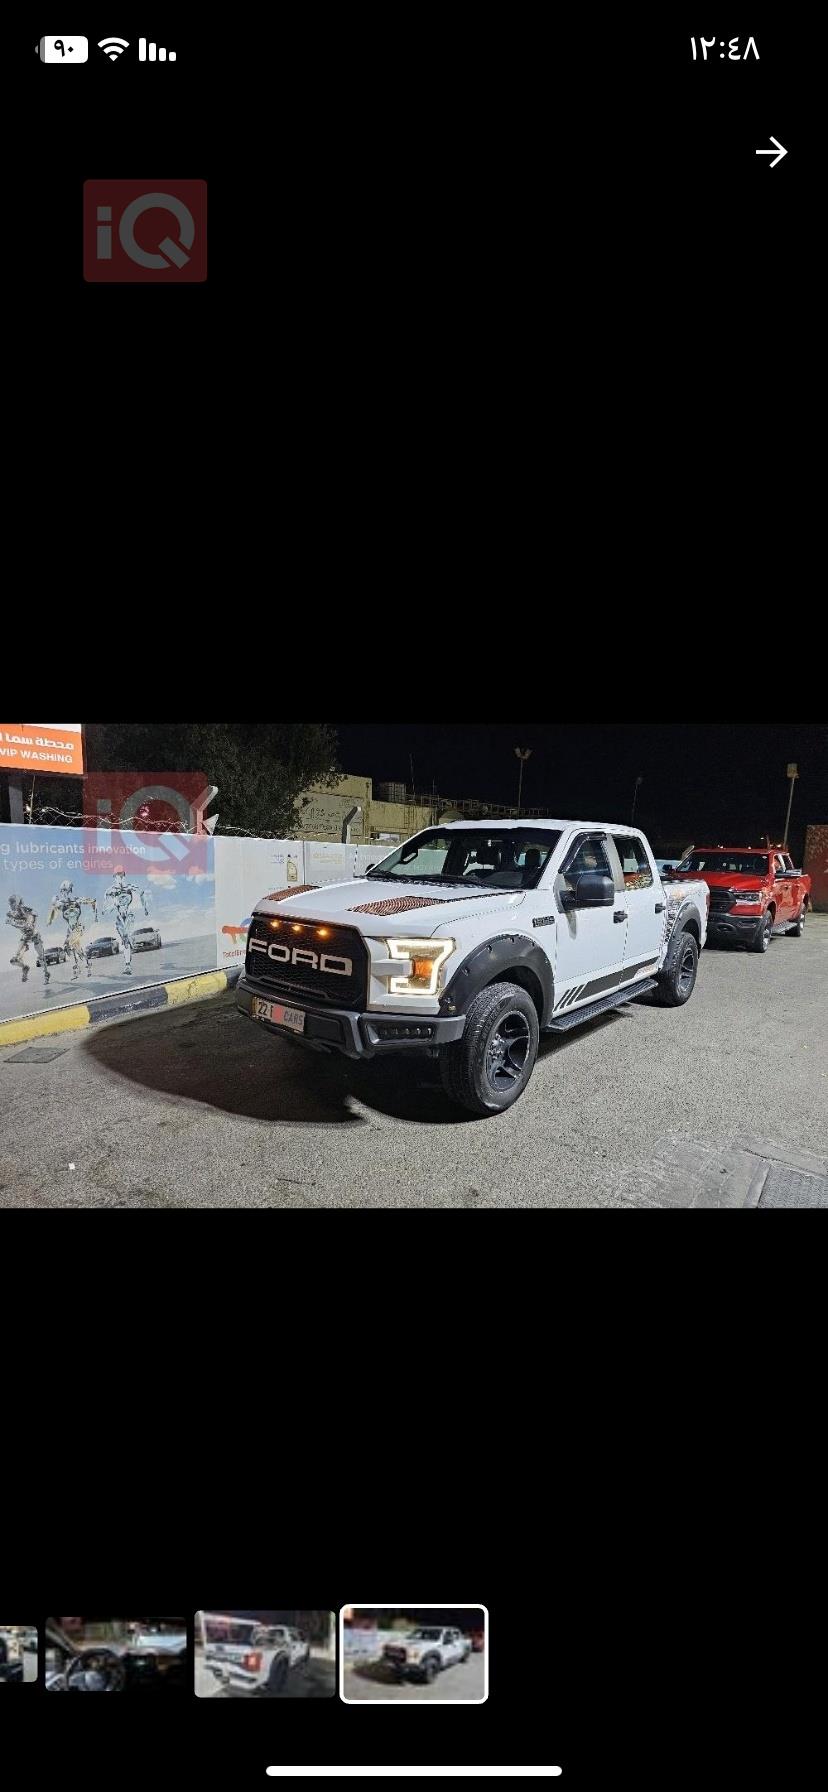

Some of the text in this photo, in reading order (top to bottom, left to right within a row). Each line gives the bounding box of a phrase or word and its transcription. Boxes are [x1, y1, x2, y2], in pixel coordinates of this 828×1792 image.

[5, 732, 33, 745] سما
[35, 736, 74, 750] محطة
[0, 747, 73, 763] VIP WASHING
[16, 841, 85, 854] lubricants
[88, 844, 146, 854] innovation
[4, 858, 114, 872] types of engines
[249, 938, 352, 976] FORD
